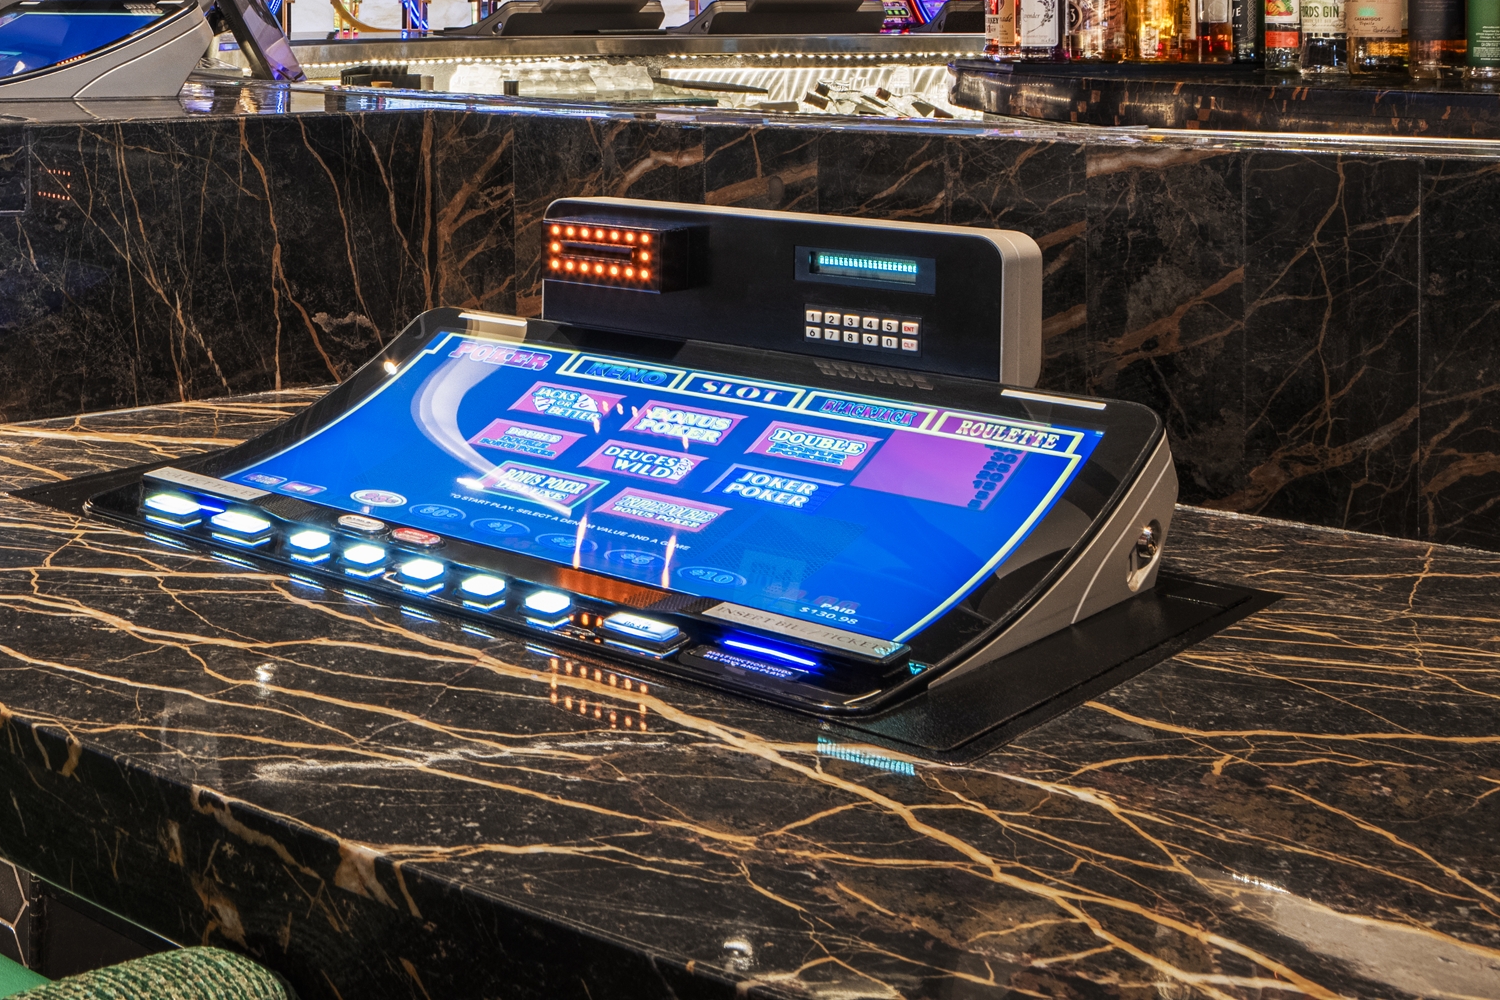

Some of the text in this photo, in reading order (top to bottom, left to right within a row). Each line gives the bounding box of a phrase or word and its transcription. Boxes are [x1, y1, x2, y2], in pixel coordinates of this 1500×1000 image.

[1323, 5, 1339, 18] GIN
[810, 313, 815, 321] 1
[828, 315, 834, 324] 2
[847, 318, 853, 326] 3
[866, 320, 873, 328] 4
[886, 322, 892, 330] 5
[809, 329, 815, 337] 6
[828, 331, 834, 339] 7
[847, 333, 853, 342] 8
[866, 335, 873, 344] 9
[886, 338, 892, 346] 0
[449, 341, 552, 371] POKER
[585, 361, 668, 386] KENO
[532, 386, 581, 403] JACKS
[700, 380, 783, 403] SLOT
[546, 404, 602, 423] BETTER
[557, 400, 573, 409] OR
[820, 399, 917, 428] BLACKJACK
[649, 405, 733, 432] BONUS
[504, 426, 563, 444] DOUBLE
[633, 418, 723, 445] POKER
[768, 428, 867, 456] DOUBLE
[956, 420, 1062, 451] ROULETTE
[603, 446, 678, 468] DEUCES
[614, 458, 674, 479] WILD
[503, 468, 589, 495] BONUS POKER
[737, 471, 819, 497] JOKER
[723, 482, 810, 508] POKER
[450, 492, 461, 501] TO
[461, 495, 487, 507] START
[516, 507, 547, 520] SELECT
[559, 516, 596, 530] DENM
[596, 525, 629, 539] VALUE
[627, 532, 649, 543] AND
[660, 540, 691, 551] GME
[487, 520, 513, 532] $1
[611, 505, 701, 529] BONUS POKER
[688, 567, 734, 584] $10
[716, 606, 777, 625] INSERT
[775, 618, 809, 633] BILL
[798, 606, 859, 626] $130.98
[820, 602, 856, 615] PAID
[703, 654, 718, 662] ALL
[740, 662, 760, 671] AND
[759, 667, 787, 679] PLAYS
[706, 650, 794, 676] MALFUNCTION VOIDS
